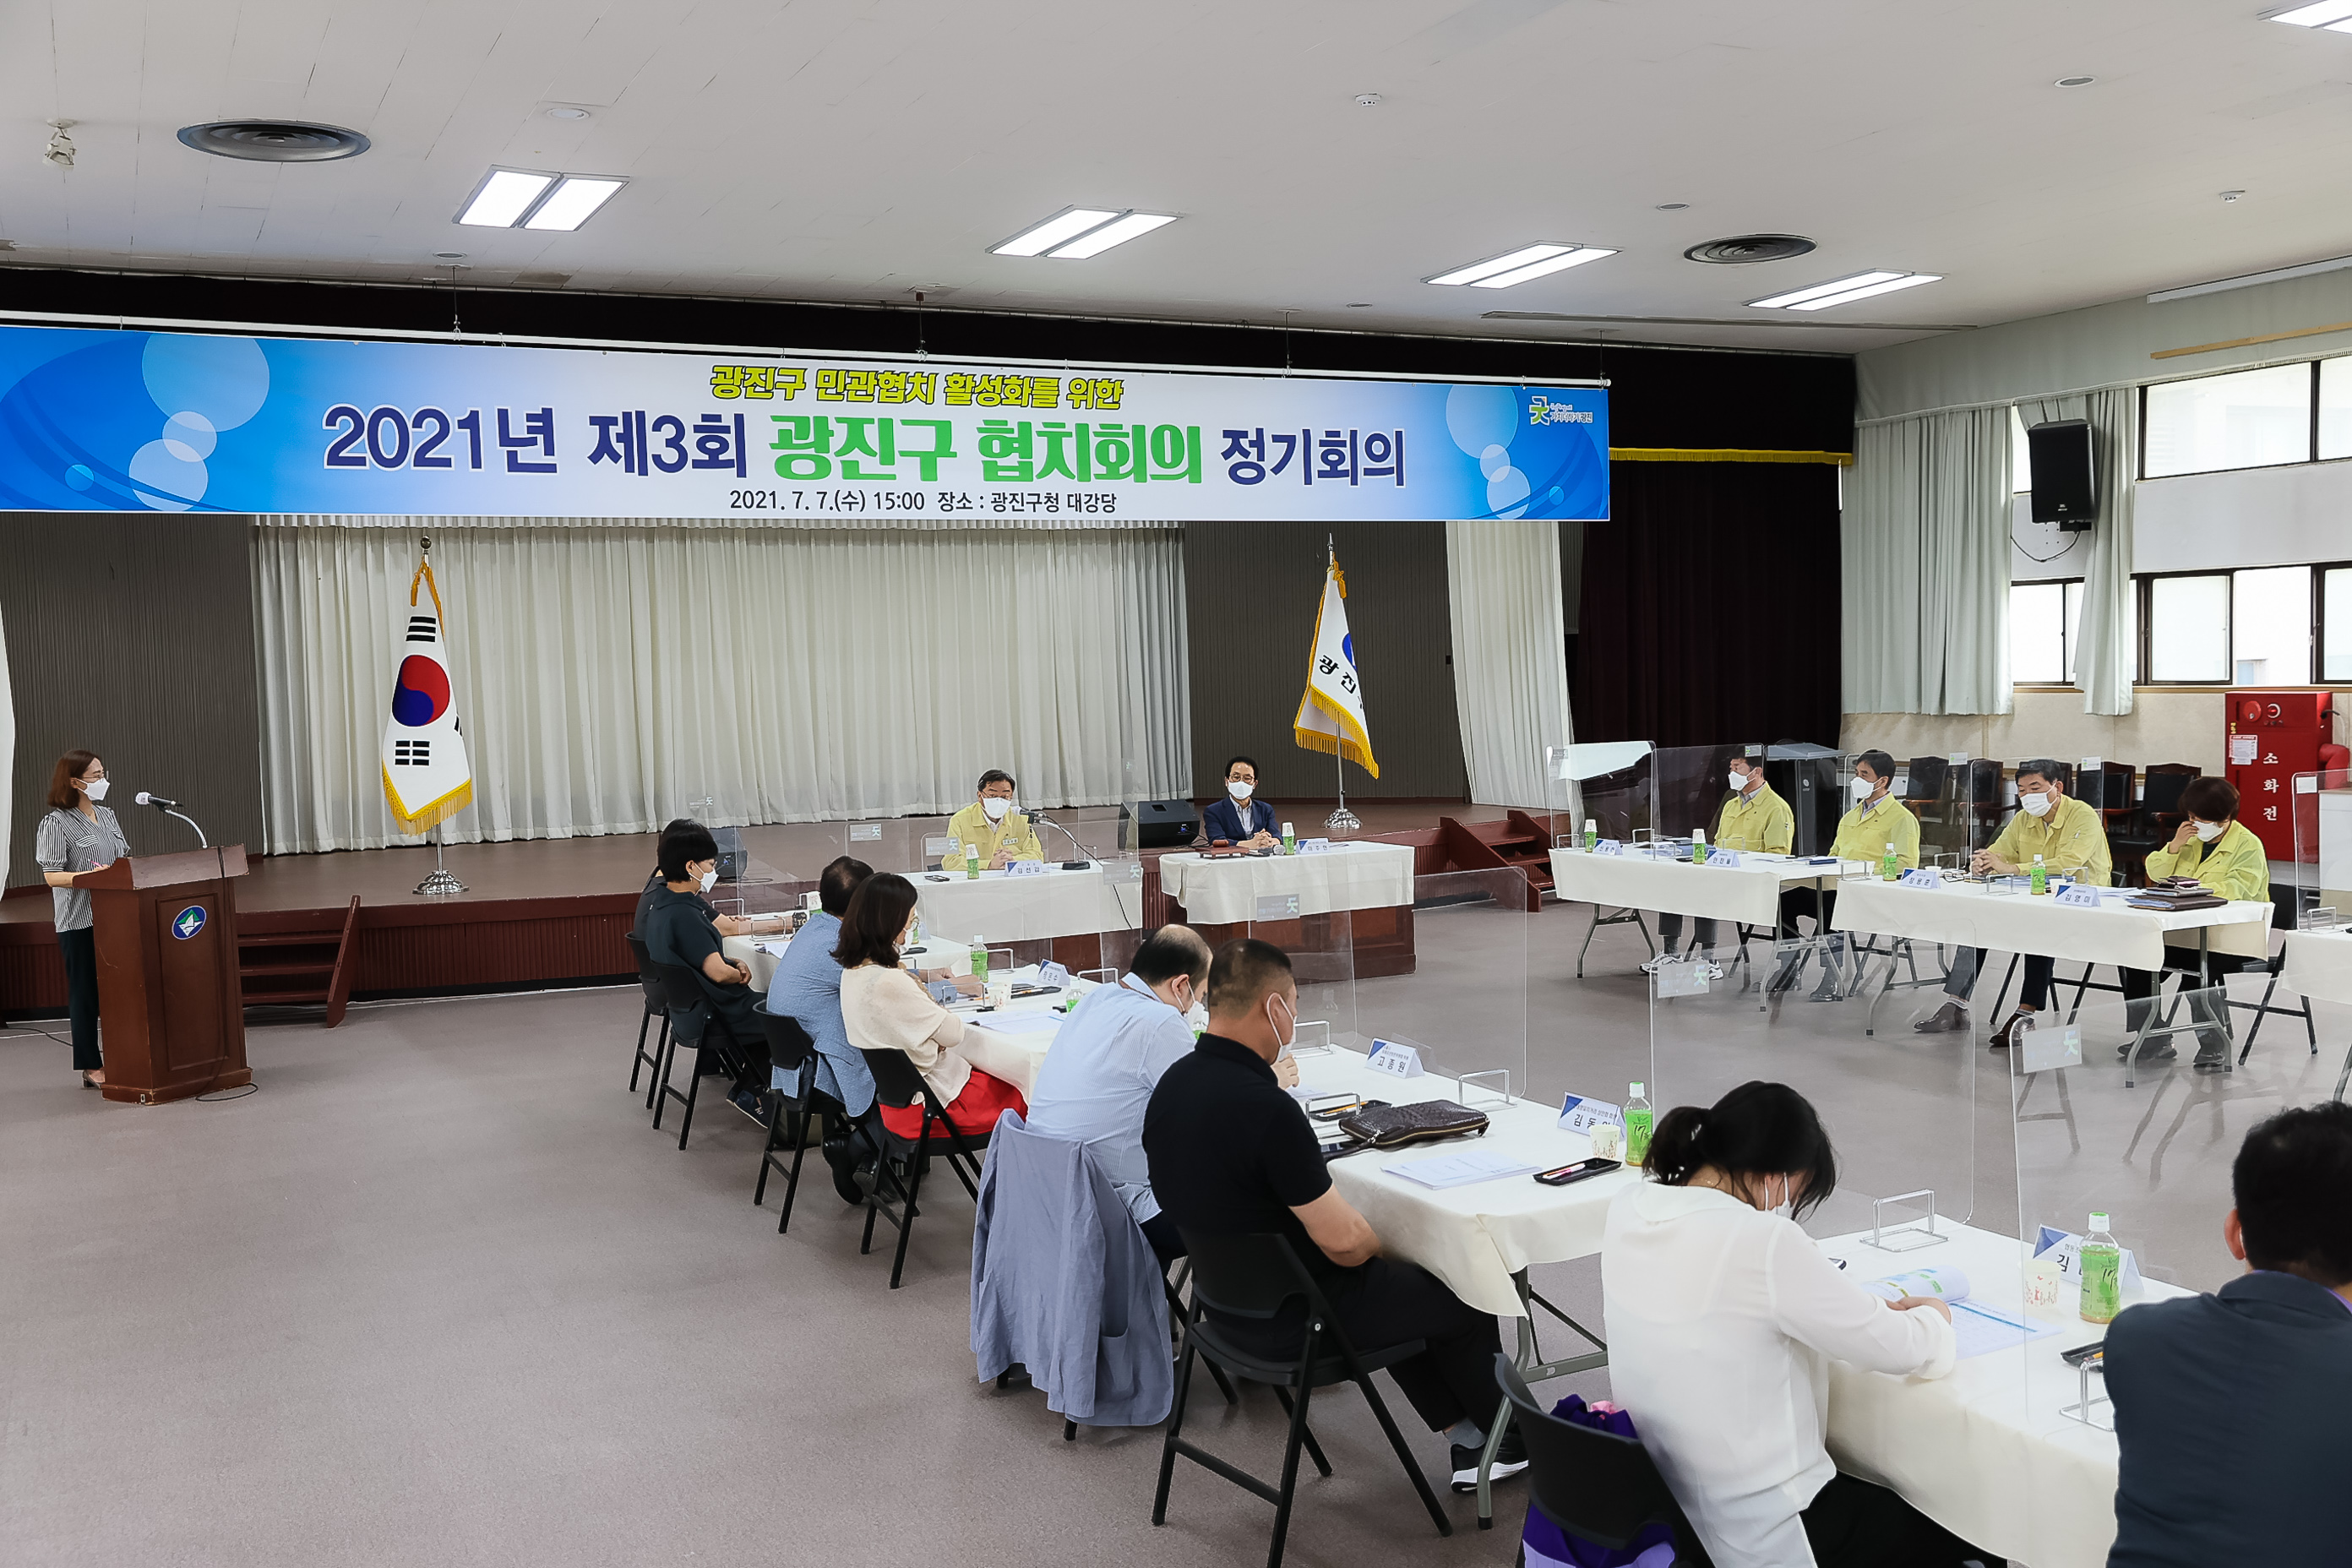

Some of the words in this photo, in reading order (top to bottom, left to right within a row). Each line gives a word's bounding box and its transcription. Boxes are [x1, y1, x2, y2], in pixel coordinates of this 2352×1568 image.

[710, 365, 808, 400] 광진구
[815, 369, 939, 405] 민관협치
[944, 373, 1061, 408] 활성화를
[1066, 378, 1124, 410] 위한
[324, 405, 558, 474] 2021년
[587, 410, 748, 478] 제3회
[769, 415, 957, 482] 광진구
[977, 419, 1202, 483] 협치회의
[1220, 427, 1405, 487] 정기회의
[730, 490, 785, 510] 2021.
[874, 492, 925, 510] 15:00
[937, 491, 973, 512] 장소
[990, 492, 1059, 513] 광진구청
[1067, 493, 1117, 513] 대강당
